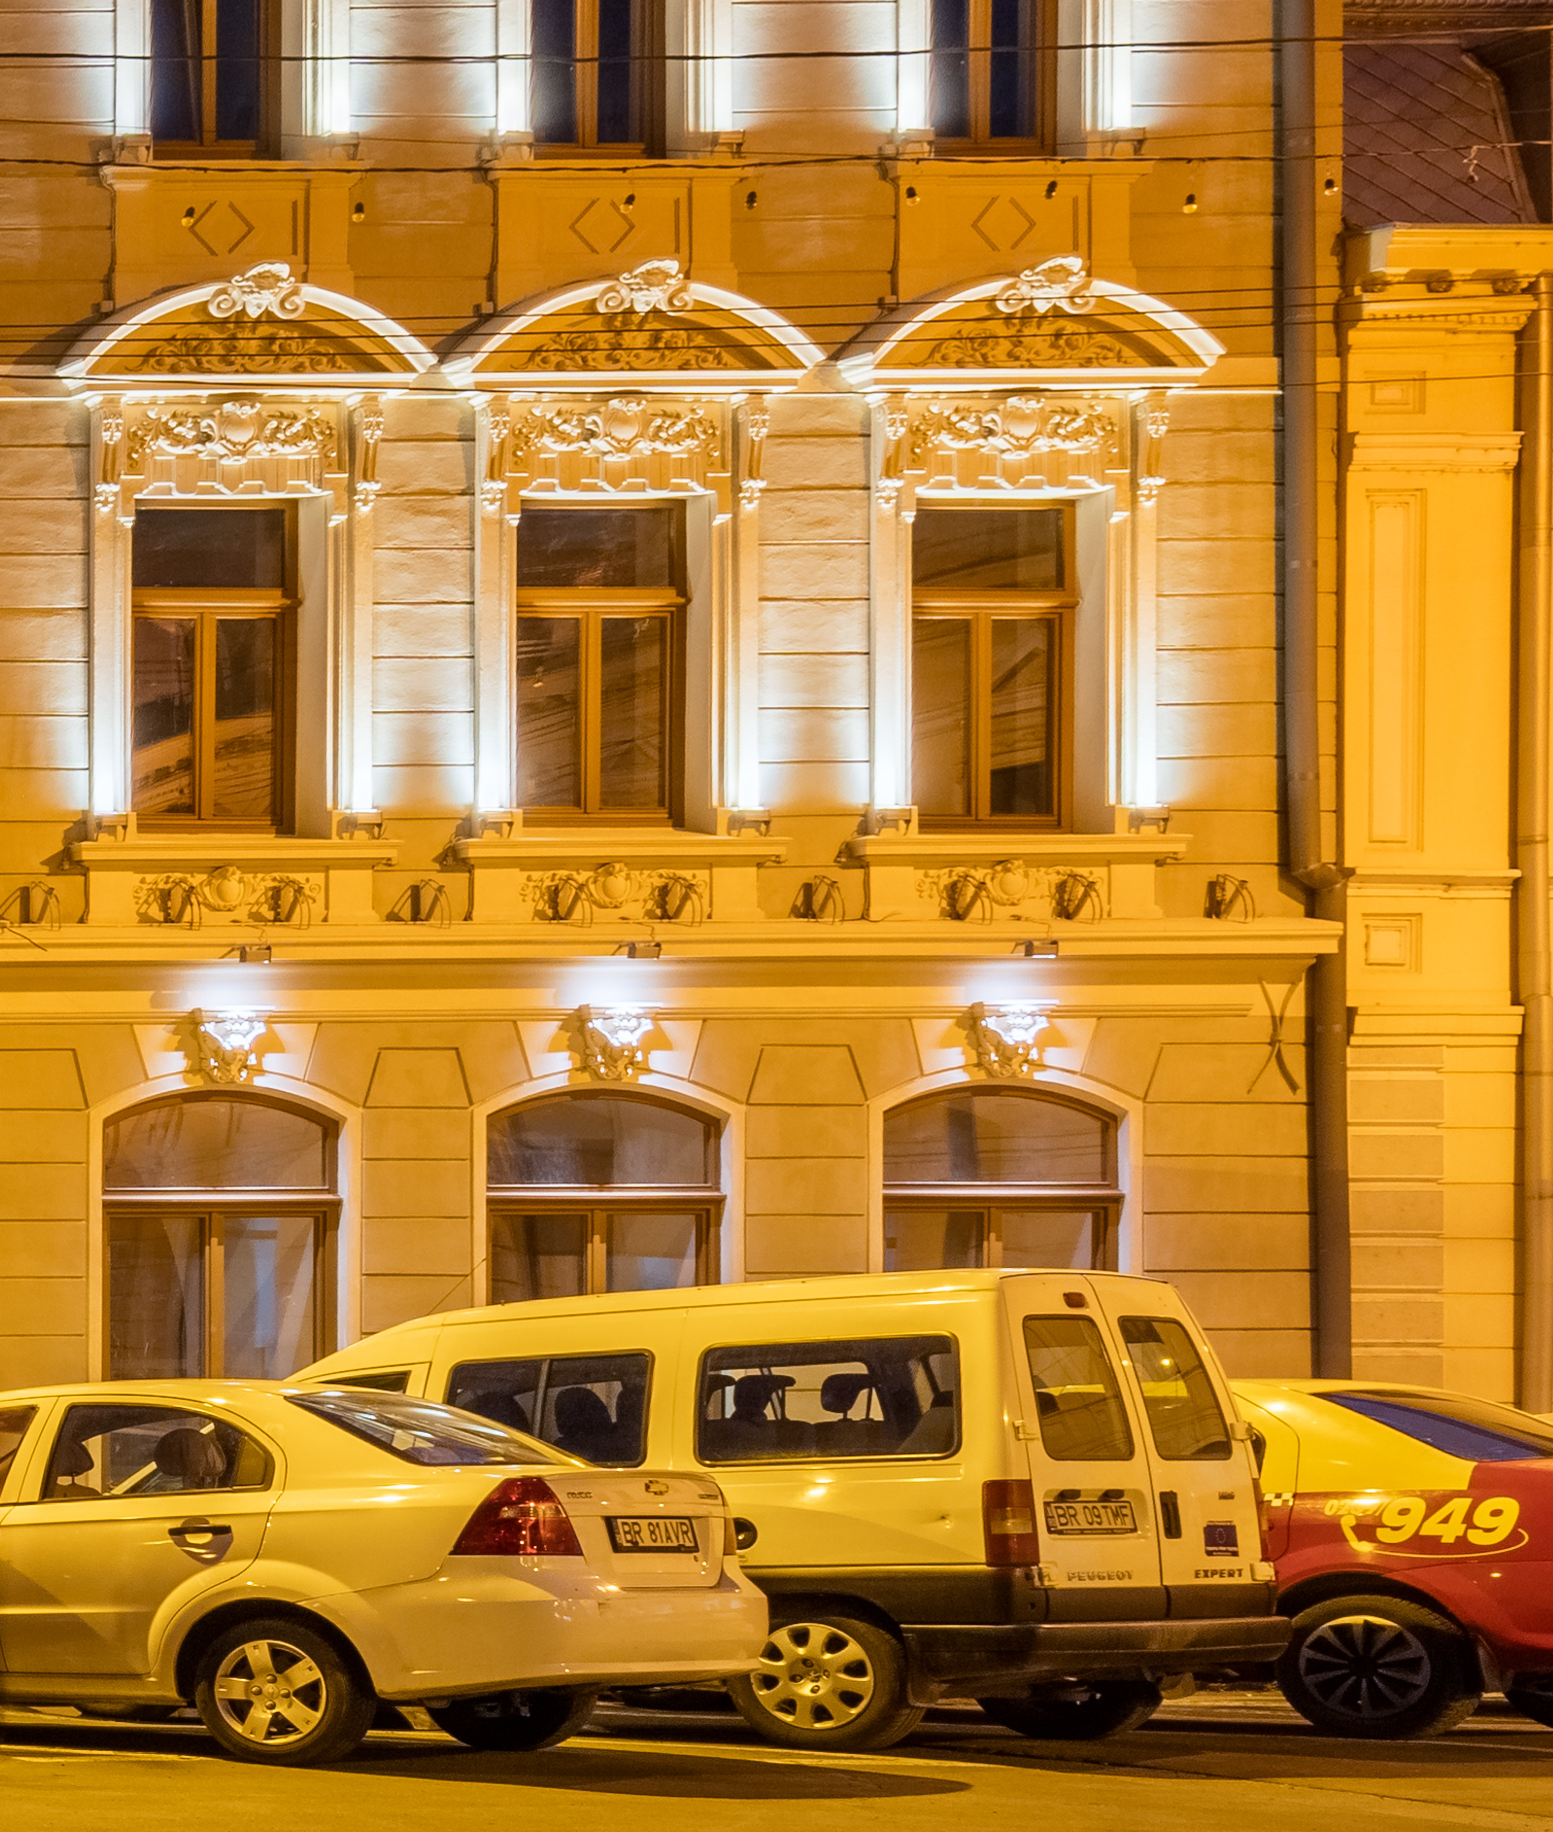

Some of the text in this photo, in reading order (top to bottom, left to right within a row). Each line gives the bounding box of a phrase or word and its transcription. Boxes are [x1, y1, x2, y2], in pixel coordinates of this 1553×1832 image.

[1054, 1505, 1081, 1527] BR
[1376, 1496, 1520, 1546] 949
[620, 1521, 644, 1544] BR
[1067, 1570, 1134, 1581] PEUGEOT
[1194, 1568, 1243, 1579] EXPERT
